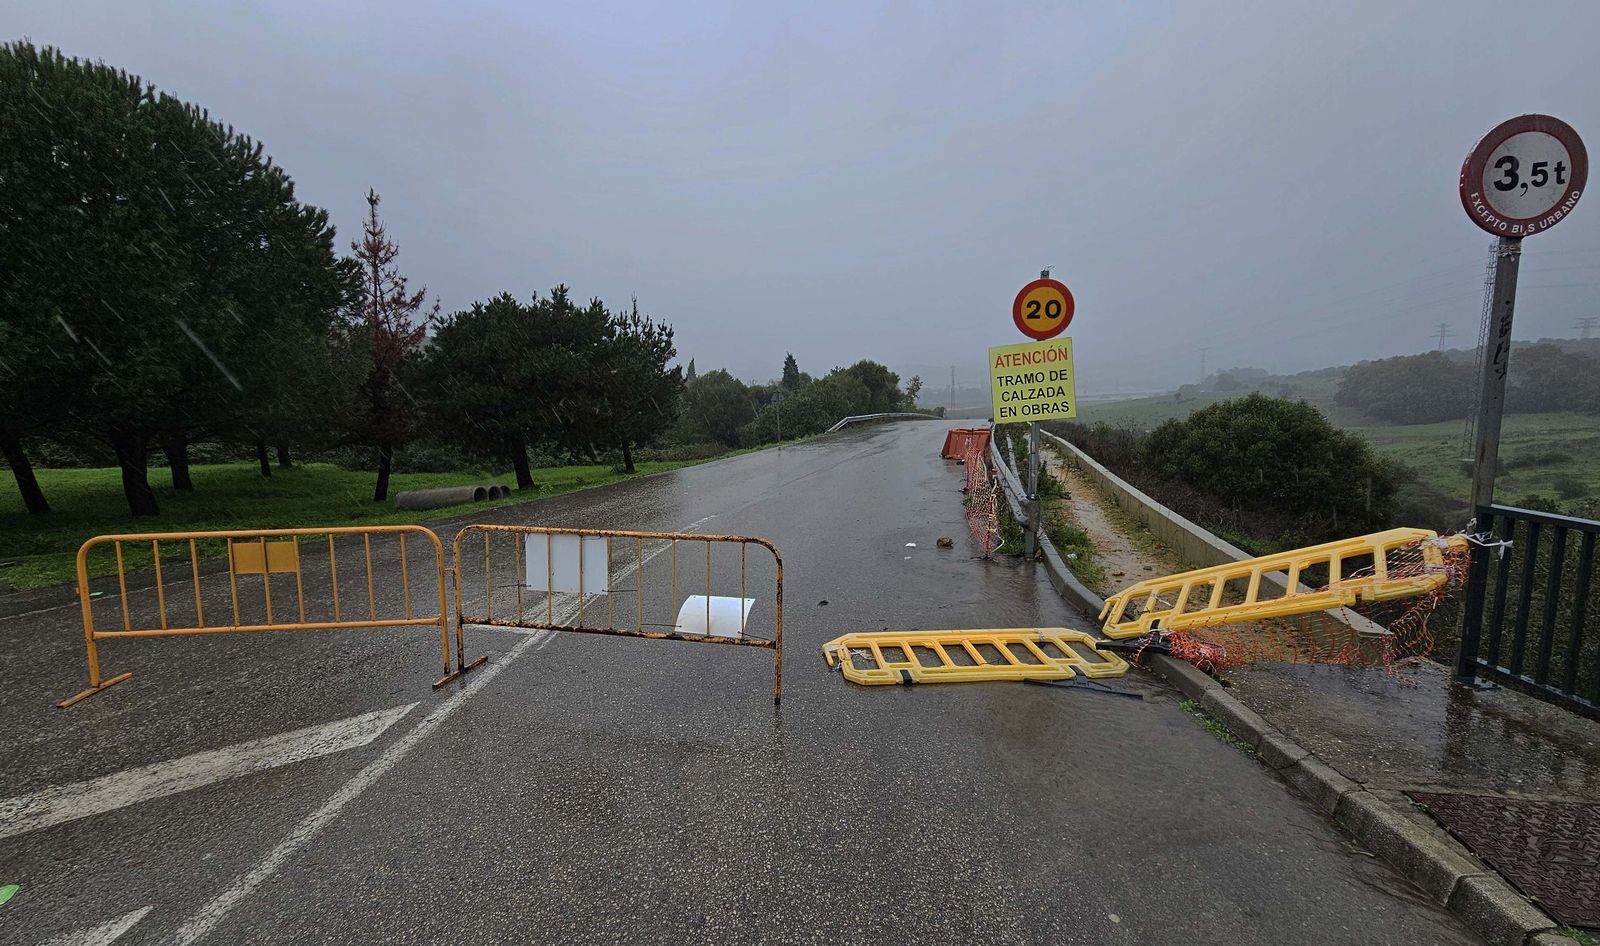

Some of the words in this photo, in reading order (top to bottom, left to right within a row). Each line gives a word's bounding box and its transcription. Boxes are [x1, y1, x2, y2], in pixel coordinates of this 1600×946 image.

[1470, 191, 1508, 231] EXCEPTO
[1540, 190, 1580, 229] URBANO
[1026, 299, 1062, 319] 20
[995, 344, 1068, 368] ATENCIÓN
[997, 371, 1045, 387] TRAMO
[1049, 369, 1068, 381] DE
[1001, 386, 1066, 402] CALZADA
[1000, 406, 1017, 418] EN
[1021, 401, 1070, 416] OBRAS
